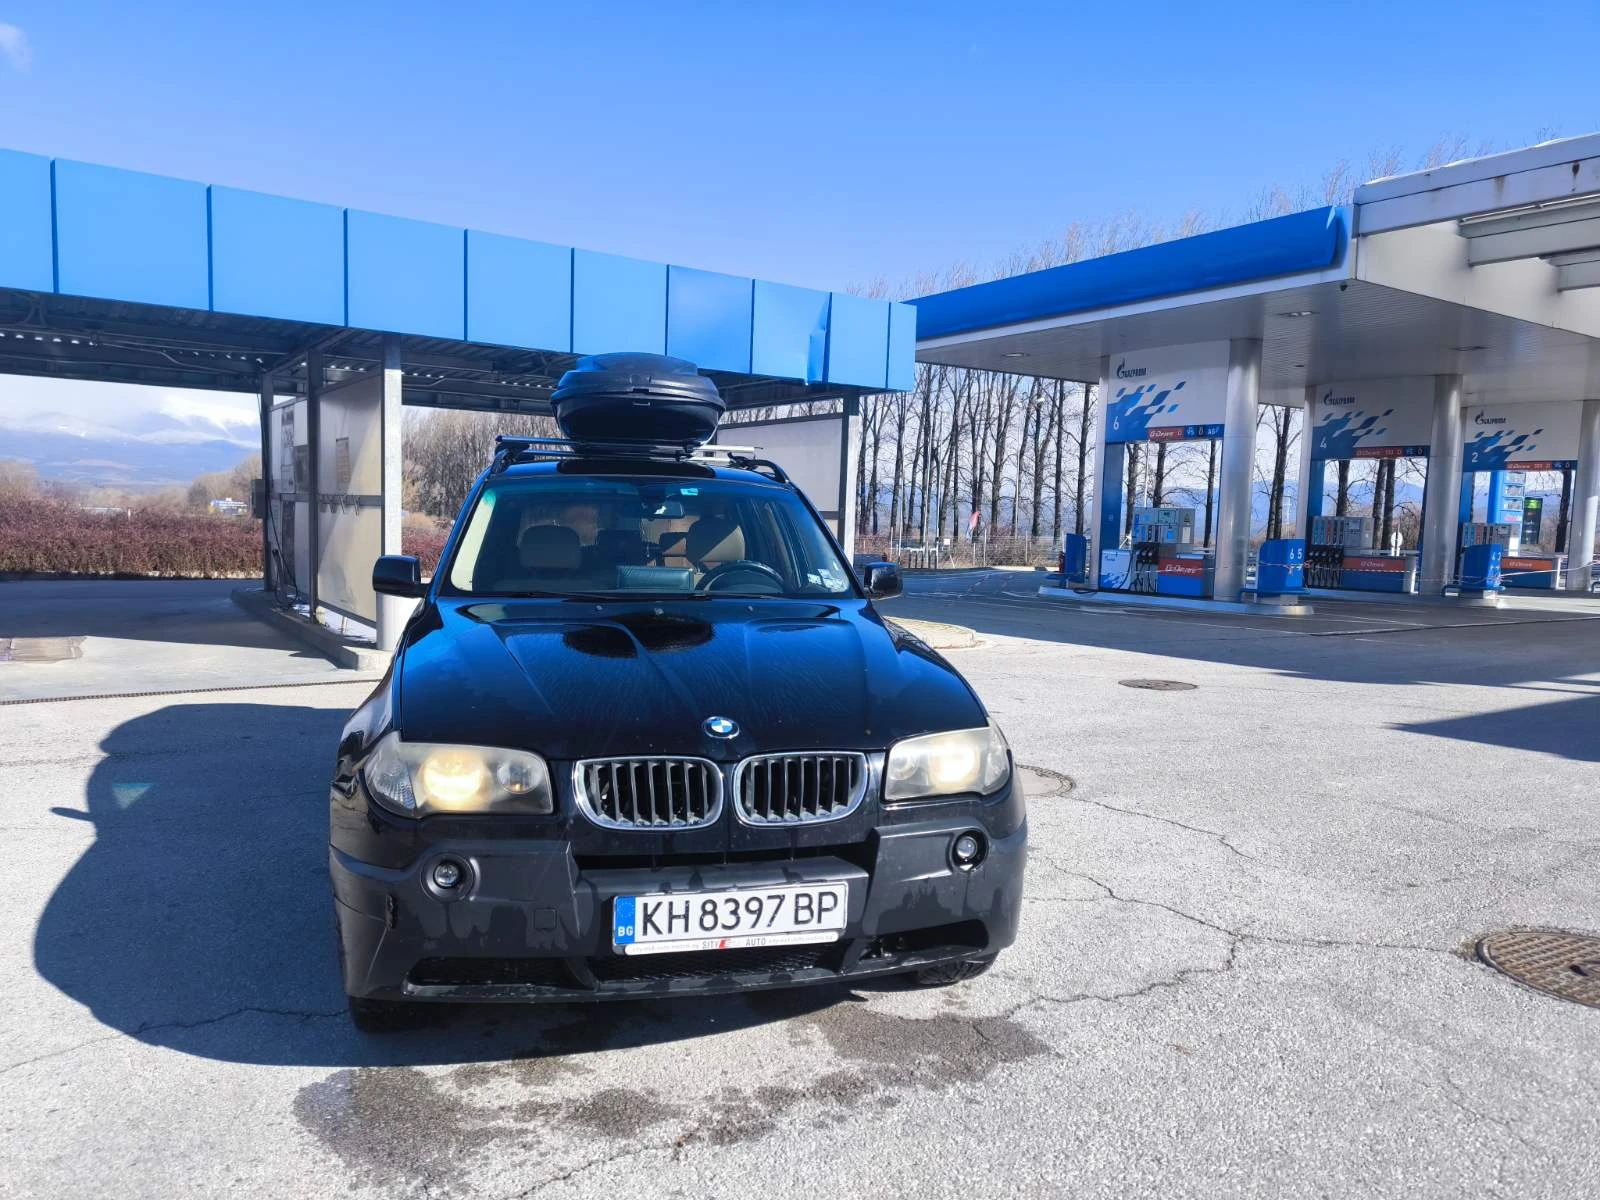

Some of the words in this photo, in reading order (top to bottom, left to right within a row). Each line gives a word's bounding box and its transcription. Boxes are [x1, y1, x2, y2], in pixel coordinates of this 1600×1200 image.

[1113, 416, 1119, 430] 6
[1320, 438, 1327, 448] 4
[1472, 452, 1479, 463] 2
[642, 901, 691, 936] KH
[700, 894, 786, 932] 8397
[793, 891, 839, 926] BP
[617, 926, 634, 937] BG
[745, 937, 767, 946] AUTO
